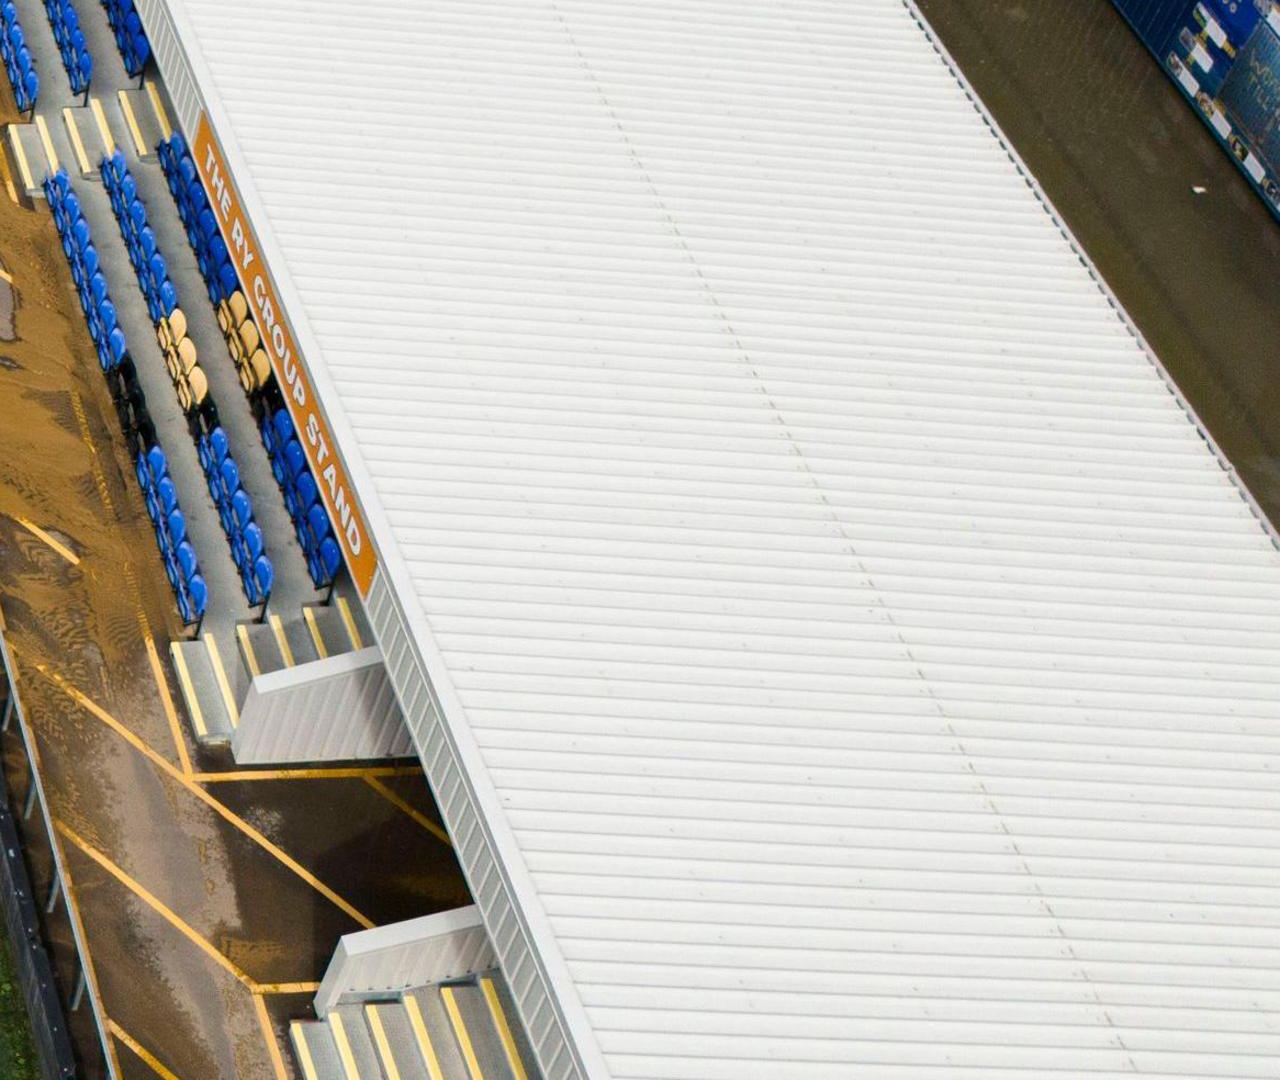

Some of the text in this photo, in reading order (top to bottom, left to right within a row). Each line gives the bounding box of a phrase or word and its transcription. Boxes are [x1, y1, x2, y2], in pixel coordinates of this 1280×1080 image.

[206, 143, 361, 556] THE RY GROUP STAND
